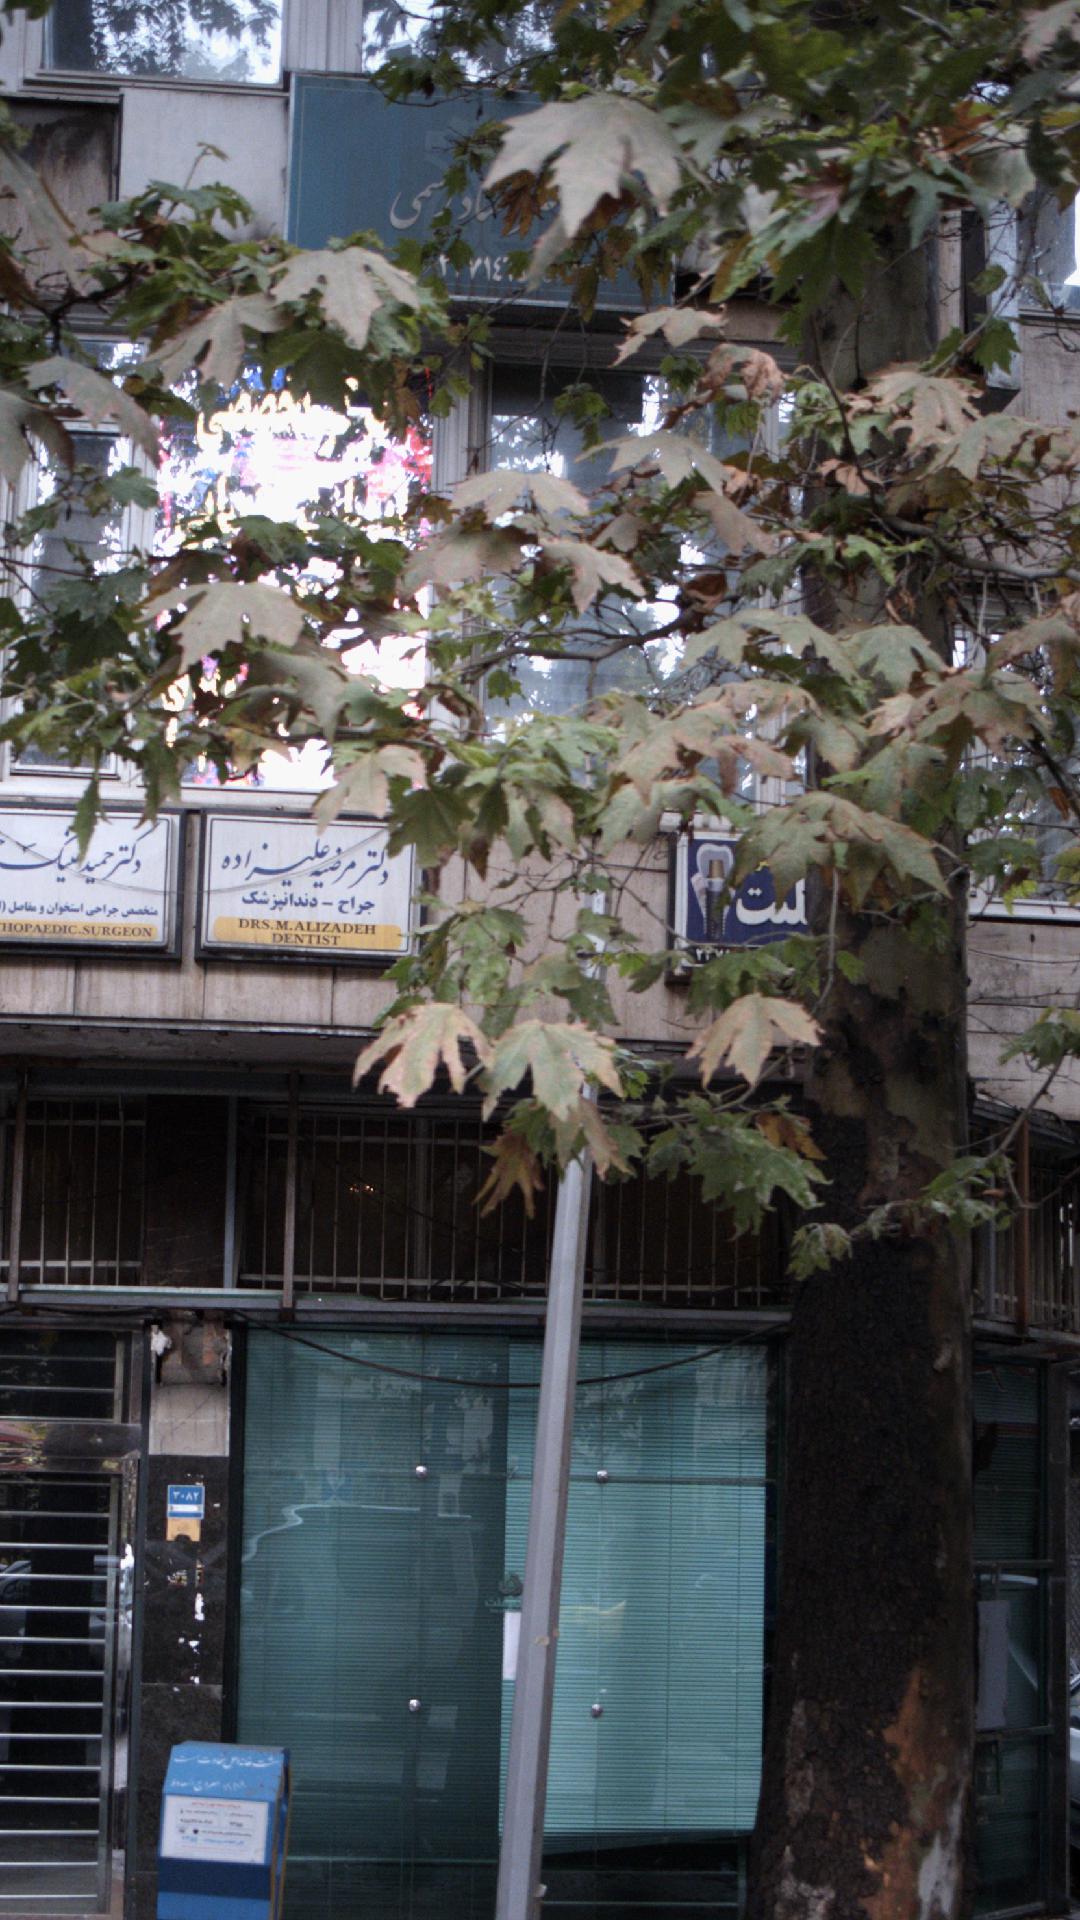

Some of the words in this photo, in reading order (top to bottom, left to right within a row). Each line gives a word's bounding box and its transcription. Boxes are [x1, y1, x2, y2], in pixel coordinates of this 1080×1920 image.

[102, 822, 160, 880] دکتر
[78, 850, 115, 884] حمید
[310, 846, 356, 888] مرضیه
[8, 901, 37, 914] مفاصل
[242, 890, 318, 911] دندانپزشک
[337, 896, 375, 915] جراح
[39, 905, 44, 914] و
[46, 902, 84, 915] استخوان
[86, 904, 119, 917] جراحی
[121, 906, 159, 918] متخصص
[0, 922, 153, 937] HOPAEDIC.SURGEON
[272, 933, 342, 946] DENTIST
